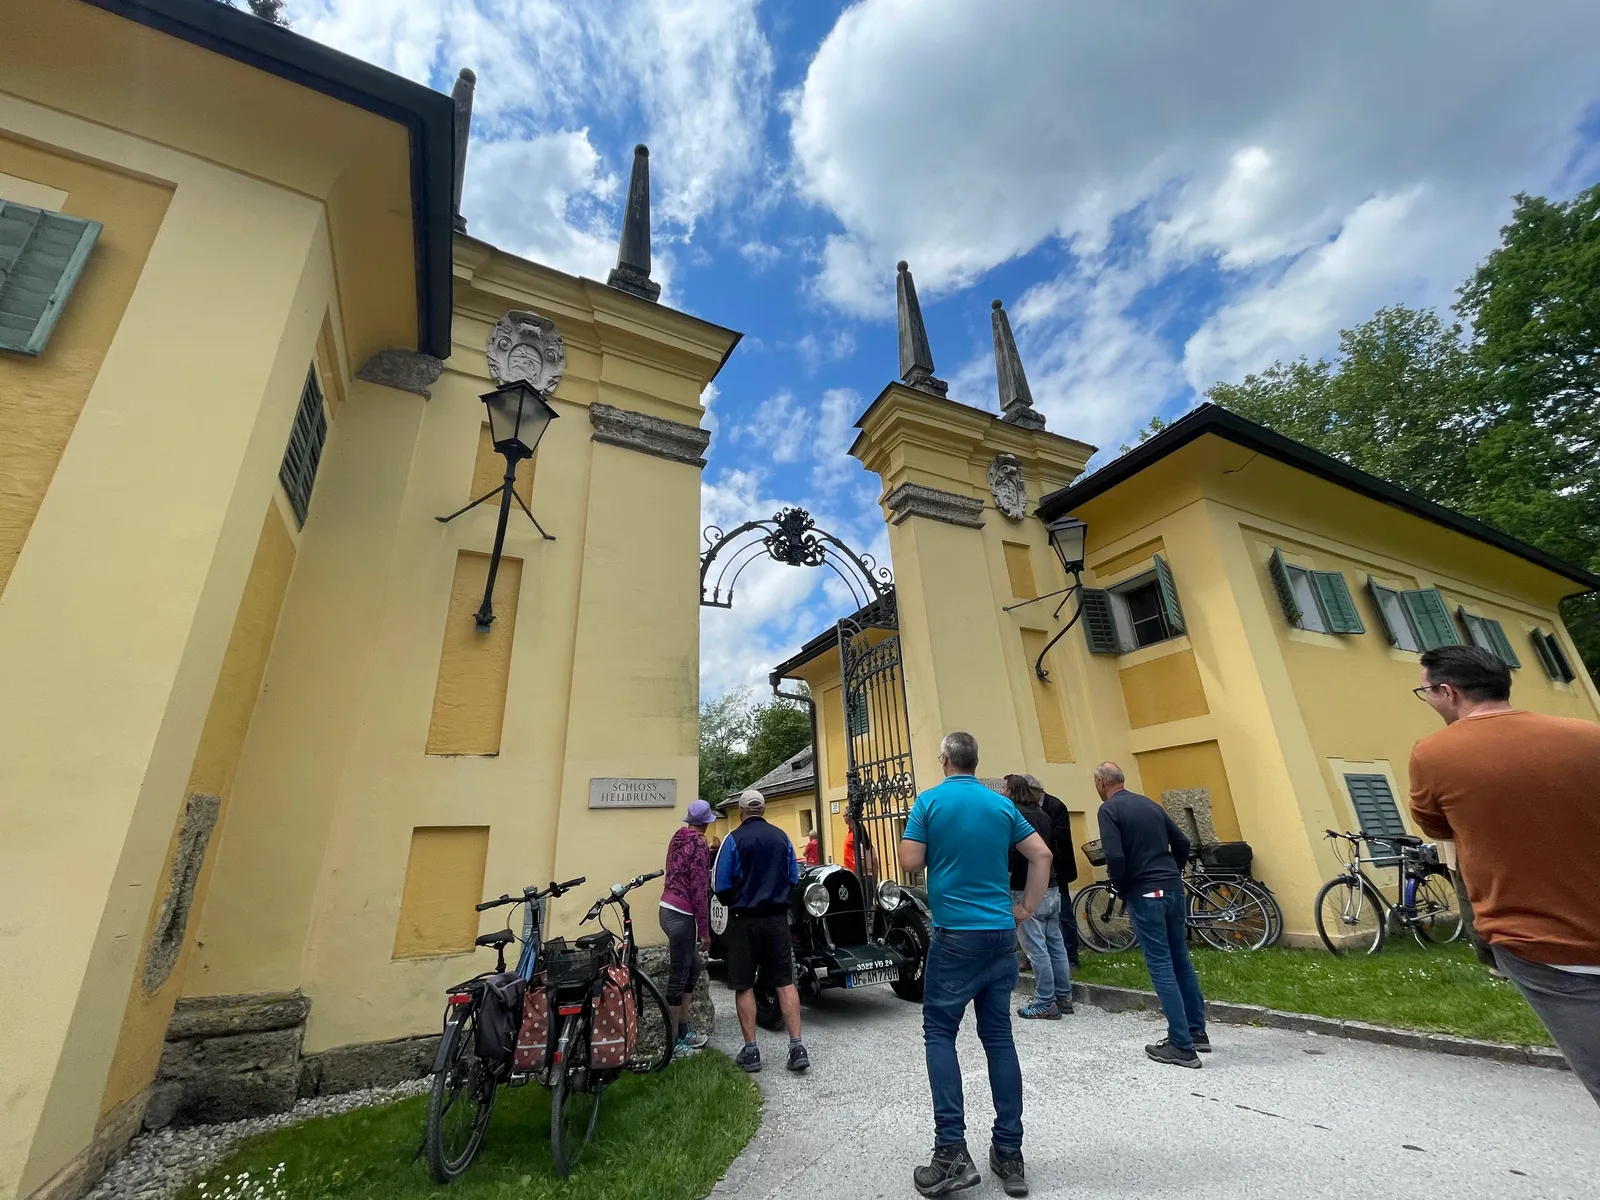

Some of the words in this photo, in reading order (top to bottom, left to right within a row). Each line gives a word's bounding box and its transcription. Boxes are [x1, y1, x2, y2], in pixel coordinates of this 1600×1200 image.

[612, 782, 657, 792] SCHLOSS
[601, 792, 667, 802] HELLBRUNN
[712, 906, 724, 919] 103
[852, 972, 863, 986] OF
